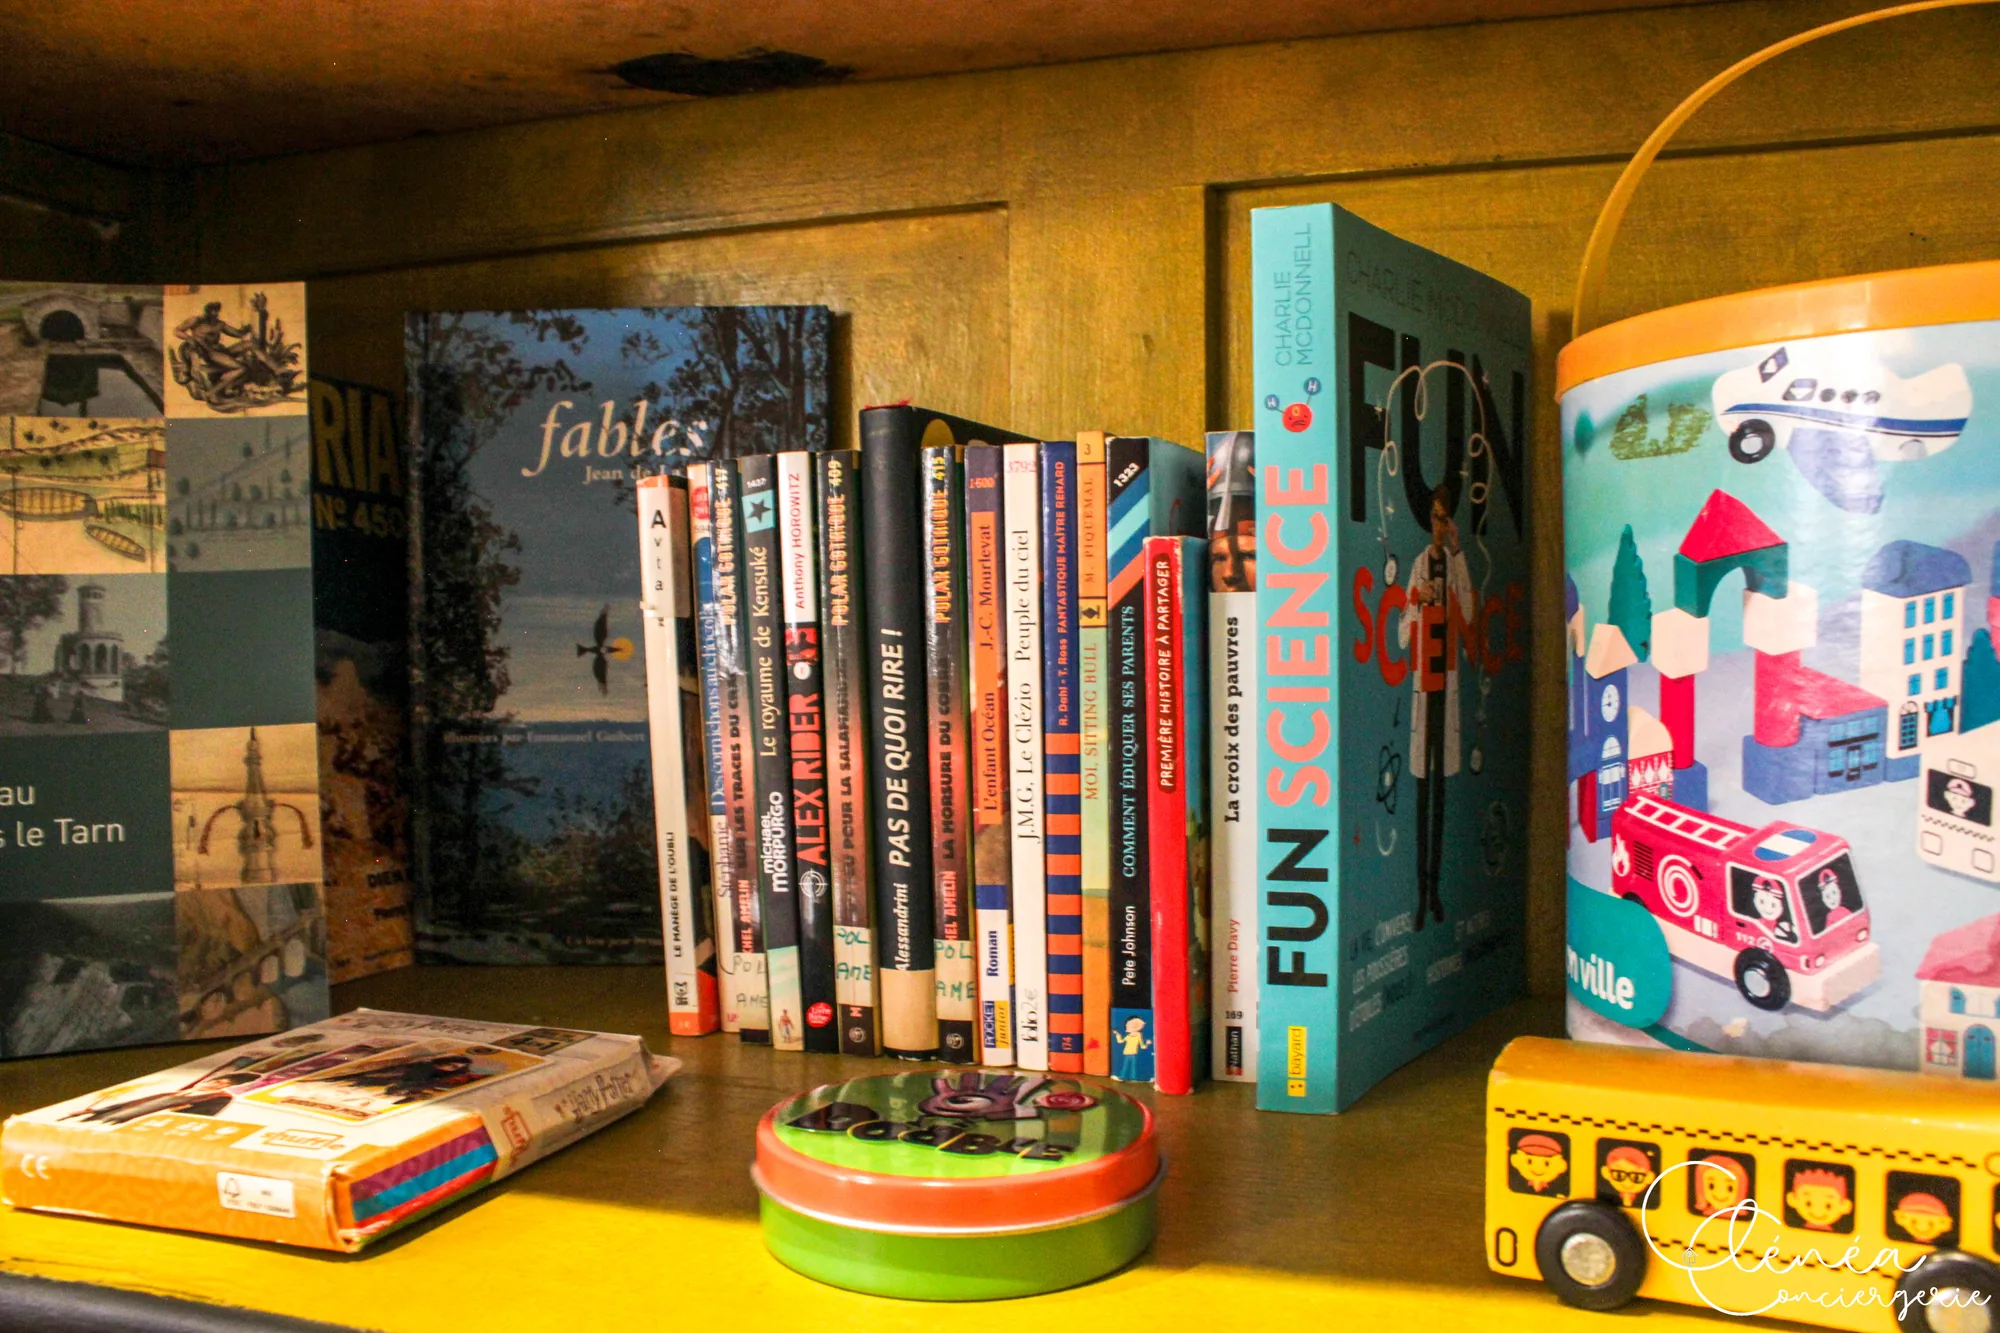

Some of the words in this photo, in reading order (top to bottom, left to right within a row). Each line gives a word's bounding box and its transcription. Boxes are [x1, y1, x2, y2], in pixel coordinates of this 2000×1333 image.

[1274, 271, 1292, 367] CHARLIE
[1295, 223, 1313, 366] MCDONNELL
[521, 398, 709, 478] fables
[1348, 311, 1525, 545] FUN
[583, 464, 624, 486] Jean
[1054, 461, 1066, 509] RENARD
[1113, 462, 1141, 488] 1323
[788, 472, 802, 548] HOROWITZ
[827, 493, 848, 572] GOTHIQUE
[931, 489, 950, 568] GOTHIQUE
[1083, 477, 1094, 558] PIQUEMAL
[977, 524, 994, 607] Mourlevat
[1011, 529, 1029, 562] ciel
[748, 546, 770, 618] Kensuké
[791, 552, 806, 610] Anthony
[830, 574, 850, 627] POLAR
[934, 571, 953, 624] POLAR
[1012, 569, 1030, 597] du
[1055, 551, 1067, 634] FANTASTIQUE
[1155, 560, 1171, 632] PARTAGER
[753, 626, 772, 648] de
[1013, 598, 1037, 661] Peuple
[1057, 638, 1068, 665] Ross
[1121, 604, 1135, 676] PARENTS
[1265, 464, 1331, 808] SCIENCE
[880, 643, 905, 701] RIRE
[1083, 642, 1097, 683] BULL
[1157, 649, 1173, 715] HISTOIRE
[1226, 616, 1243, 697] pauvres
[757, 655, 781, 730] royaume
[980, 691, 996, 743] Océan
[1014, 682, 1032, 744] Clézio
[1058, 686, 1069, 712] Dahl
[1121, 680, 1135, 707] SES
[728, 714, 741, 739] DU
[788, 692, 824, 781] RIDER
[883, 706, 911, 772] QUOI
[938, 722, 953, 746] DU
[1083, 690, 1099, 757] SITTING
[1223, 702, 1240, 737] des
[730, 743, 744, 801] TRACES
[759, 737, 777, 757] Le
[1016, 750, 1034, 775] Le
[1119, 714, 1138, 790] ÉDUQUER
[1156, 718, 1174, 788] PREMIÈRE
[1223, 746, 1240, 795] croix
[840, 775, 852, 795] LA
[886, 776, 910, 813] DE
[939, 751, 955, 834] MORSURE
[983, 745, 999, 812] L'enfant
[16, 820, 46, 848] le
[53, 817, 127, 846] Tarn
[733, 806, 747, 832] LES
[792, 787, 829, 867] ALEX
[841, 801, 855, 849] POUR
[1016, 781, 1041, 844] J.M.G.
[1121, 794, 1137, 878] COMMENT
[1223, 799, 1240, 823] La
[666, 831, 678, 875] L'OUBLI
[886, 816, 912, 868] PAS
[941, 838, 956, 862] LA
[669, 883, 679, 897] DE
[942, 870, 958, 917] AMELIN
[1266, 827, 1330, 988] FUN
[669, 904, 682, 945] MANÈGE
[892, 882, 911, 972] Alessandrini
[1120, 905, 1137, 957] Johnson
[1226, 918, 1242, 957] Davy
[674, 945, 683, 958] LE
[985, 930, 999, 977] Roman
[1121, 958, 1137, 986] Pete
[1227, 957, 1239, 994] Pierre
[936, 981, 977, 1002] AME
[1580, 952, 1636, 1011] ville
[983, 1001, 995, 1047] POCKET
[995, 1004, 1009, 1046] junior
[1289, 1026, 1307, 1076] bayard
